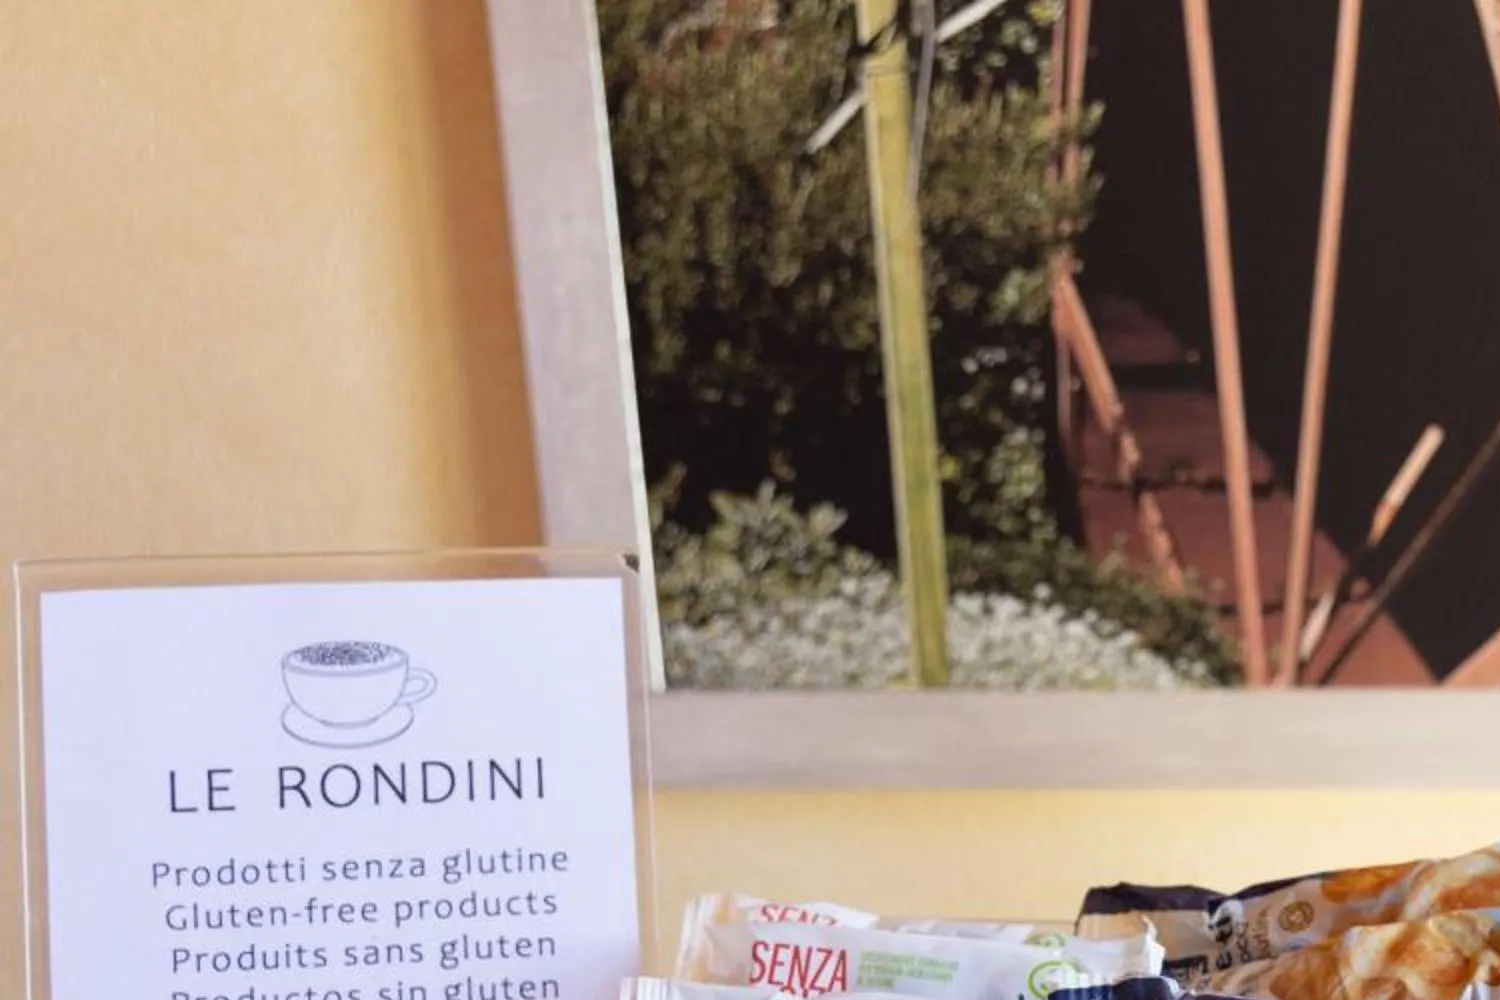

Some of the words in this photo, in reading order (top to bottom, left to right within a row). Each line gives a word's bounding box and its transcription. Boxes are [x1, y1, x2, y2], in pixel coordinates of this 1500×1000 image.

[168, 769, 236, 813] LE
[278, 757, 545, 809] RONDINI
[151, 857, 307, 888] Prodotti
[321, 857, 427, 881] senza
[441, 848, 570, 884] glutine
[165, 897, 379, 931] Gluten-free
[394, 891, 559, 928] products
[172, 941, 329, 973] Produits
[343, 942, 424, 967] sans
[438, 933, 558, 970] gluten
[747, 940, 848, 994] SENZA
